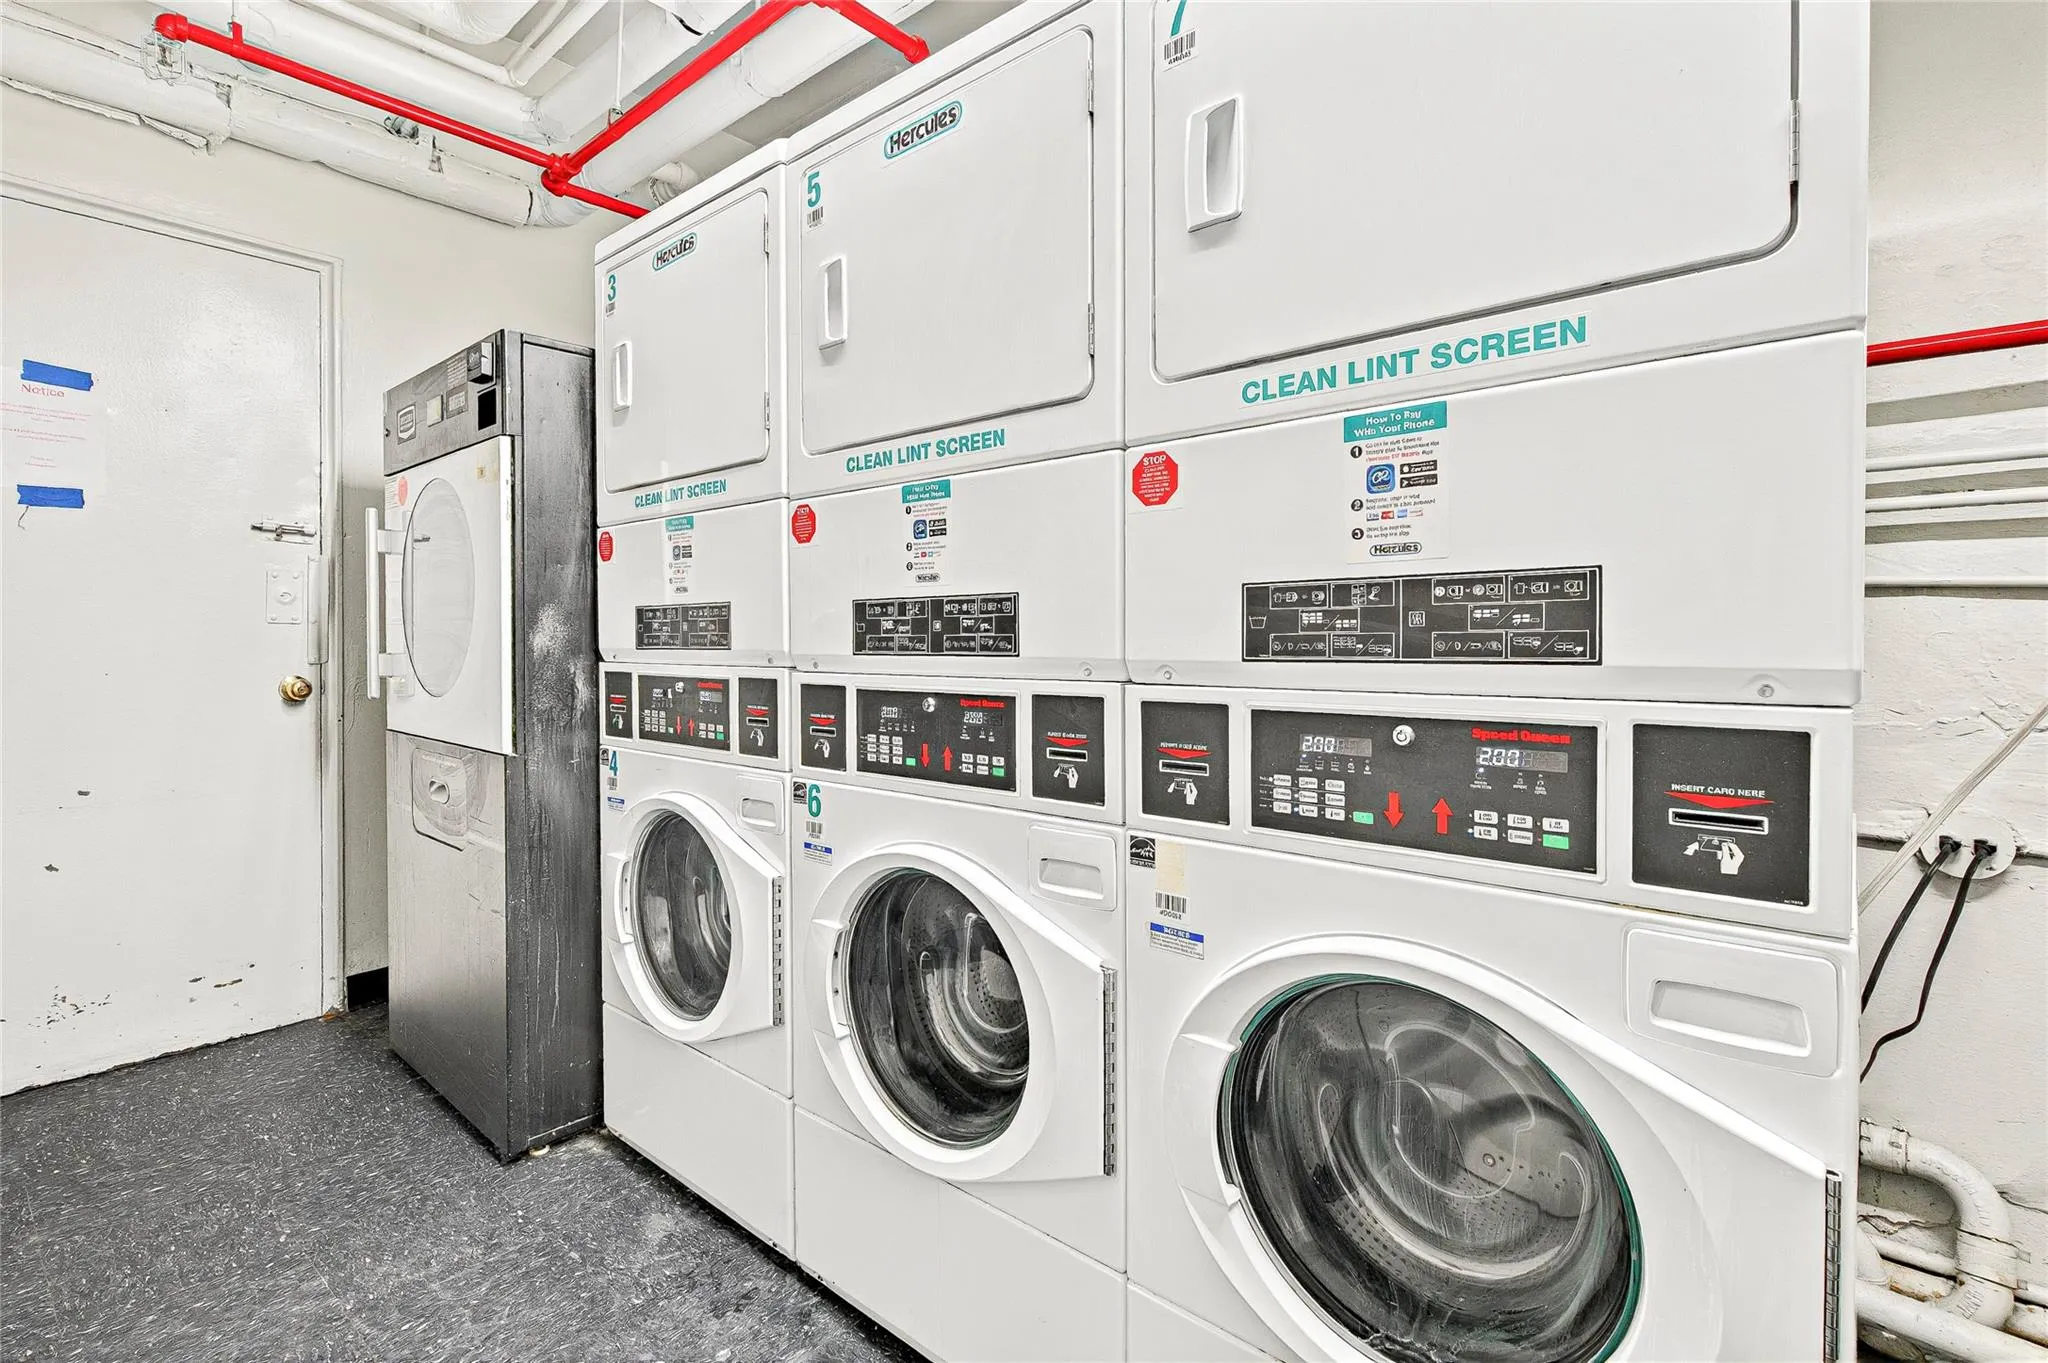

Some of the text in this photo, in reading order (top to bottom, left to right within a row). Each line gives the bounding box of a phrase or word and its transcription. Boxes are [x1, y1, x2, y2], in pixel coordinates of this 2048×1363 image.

[890, 107, 957, 153] Hercules
[807, 171, 821, 207] 5
[608, 274, 616, 301] 3
[1241, 316, 1587, 404] CLEAN LINT SCREEN
[846, 428, 1006, 473] CLEAN LINT SCREEN
[1143, 454, 1167, 466] STOP
[634, 491, 663, 508] CLEAN
[687, 479, 727, 499] SCREEN
[1472, 728, 1571, 745] Speed Queen
[609, 750, 618, 776] 4
[807, 784, 822, 817] 6
[1671, 783, 1706, 793] INSERT
